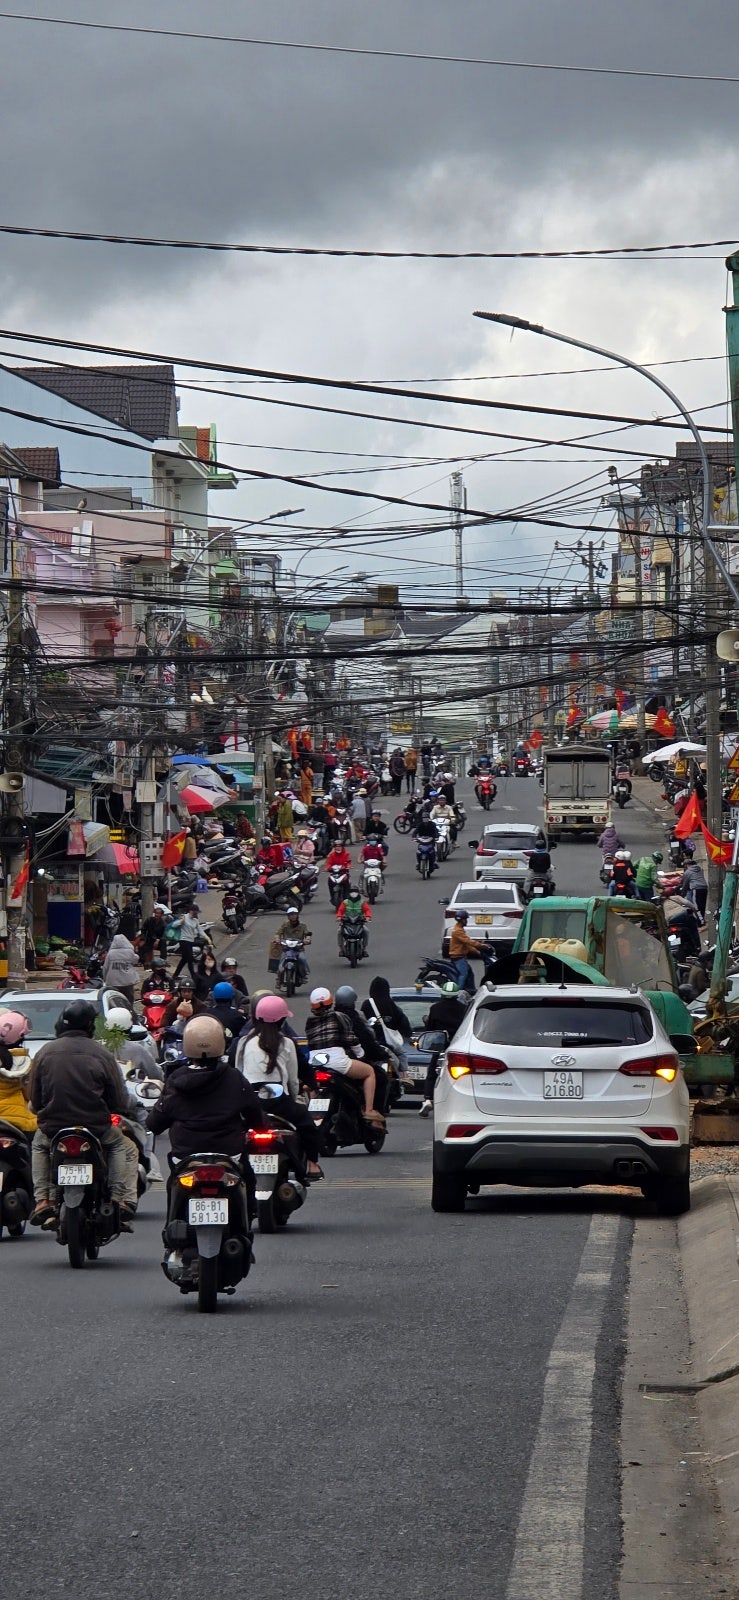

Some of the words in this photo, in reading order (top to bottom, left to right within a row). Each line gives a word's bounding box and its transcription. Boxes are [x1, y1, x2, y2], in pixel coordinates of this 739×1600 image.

[553, 1072, 574, 1085] 49A
[545, 1085, 582, 1097] 216.80
[195, 1201, 221, 1211] 86-B1
[191, 1212, 226, 1223] 581.30
